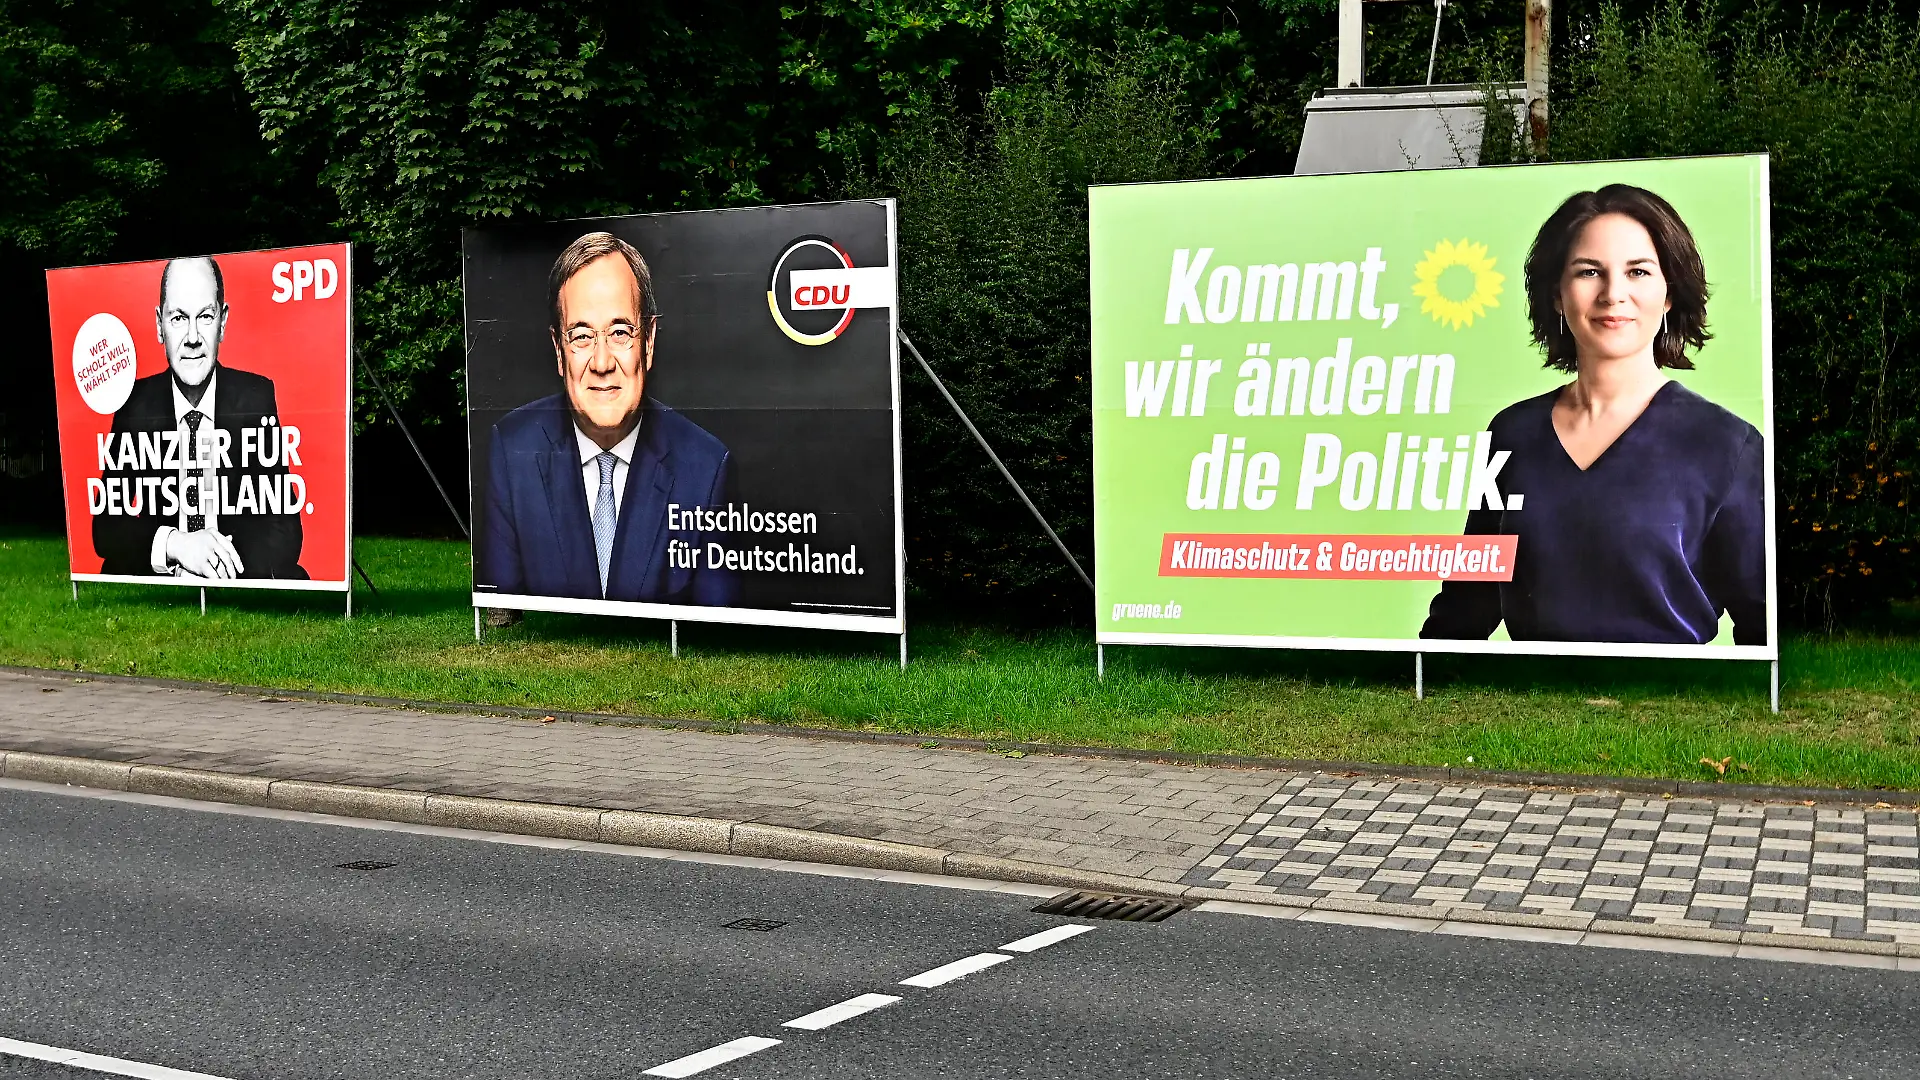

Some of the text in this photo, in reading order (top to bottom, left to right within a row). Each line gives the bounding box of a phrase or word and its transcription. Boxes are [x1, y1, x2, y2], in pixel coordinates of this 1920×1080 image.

[272, 259, 338, 303] SPD
[794, 284, 851, 305] CDU
[1164, 247, 1399, 329] Kommt,
[78, 343, 129, 381] SCHOLZ WILL,
[89, 338, 108, 356] WER
[84, 355, 130, 393] WÄHLT SPD!
[1124, 337, 1456, 418] wir ändern
[96, 415, 302, 471] KANZLER FÜR
[1186, 431, 1525, 512] die Politik.
[86, 473, 314, 516] DEUTSCHLAND.
[668, 503, 817, 534] Entschlossen
[668, 540, 864, 575] für Deutschland.
[1171, 540, 1506, 578] Klimaschutz & Gerechtigkeit.
[1111, 600, 1182, 622] gruene.de
